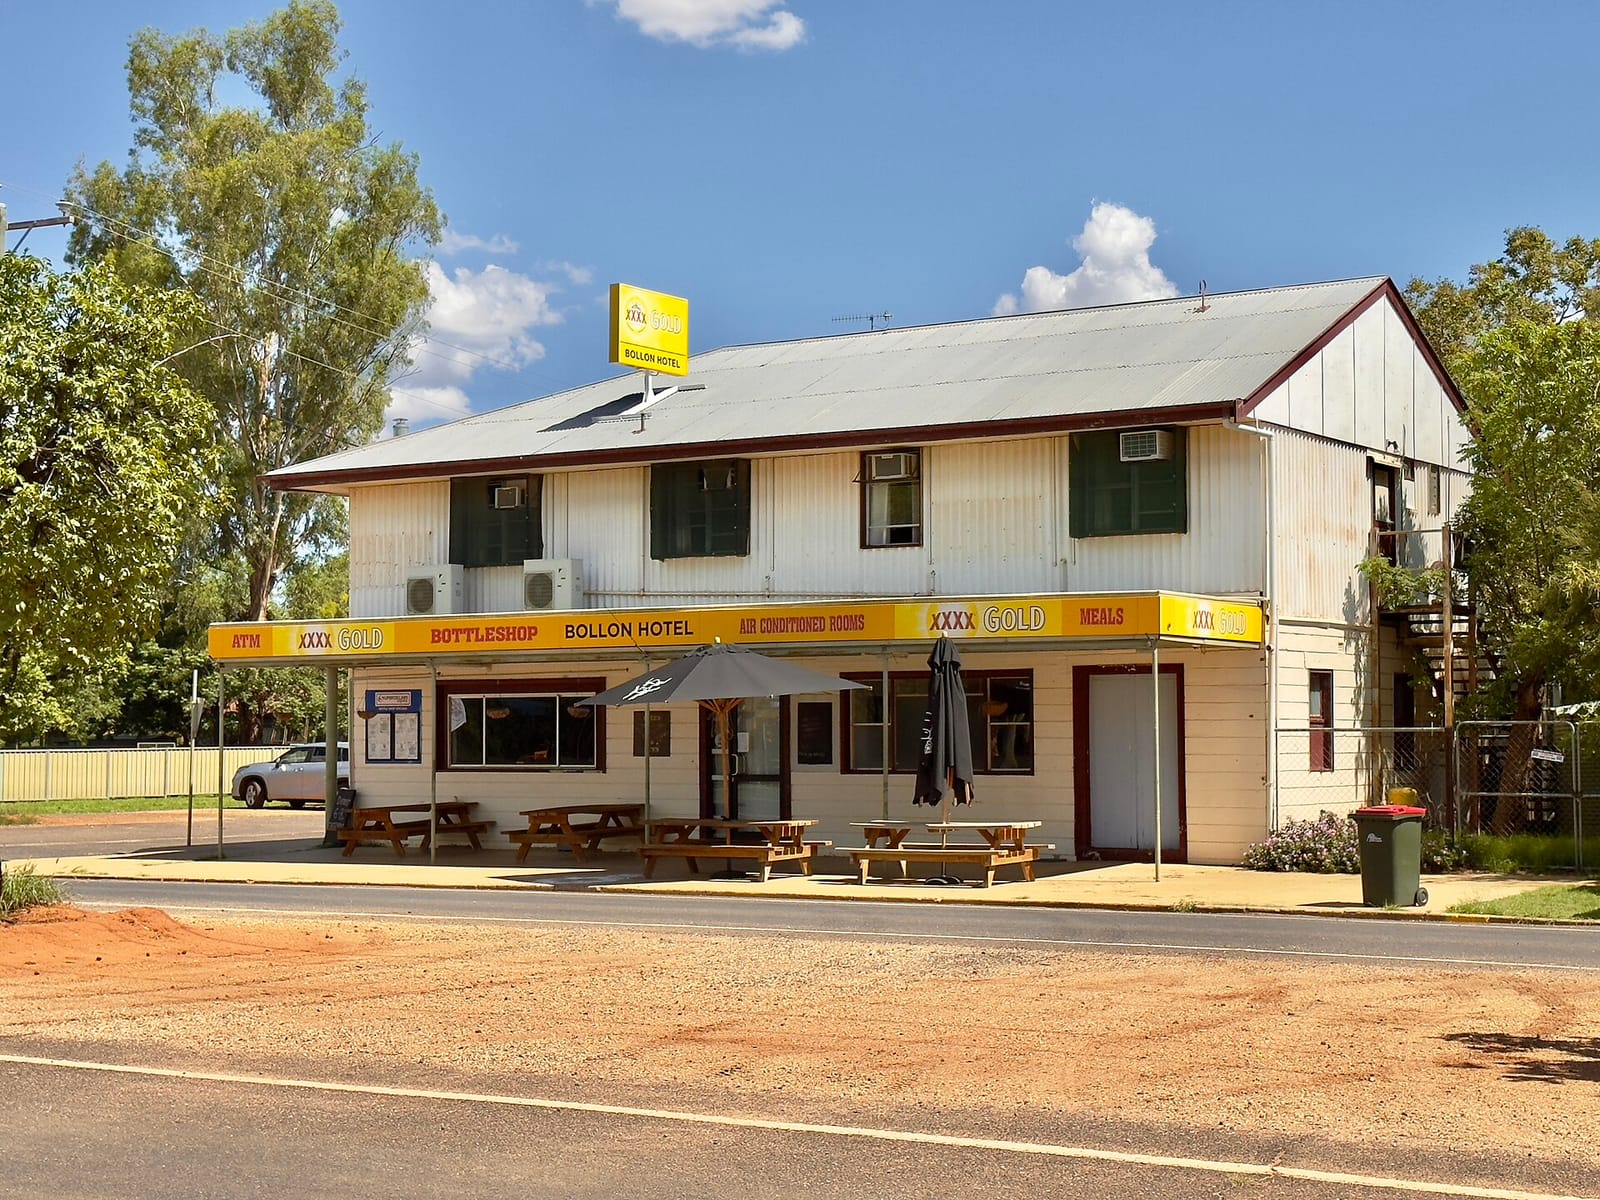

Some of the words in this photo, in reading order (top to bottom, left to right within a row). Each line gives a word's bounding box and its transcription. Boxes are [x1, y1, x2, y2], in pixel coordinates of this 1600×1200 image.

[626, 309, 647, 324] XXXX
[650, 309, 682, 334] GOLD
[625, 349, 655, 363] BOLLON
[657, 355, 681, 368] HOTEL
[740, 618, 757, 634] AIR
[760, 616, 825, 634] CONDITIONED
[829, 614, 865, 631] ROOMS
[929, 610, 976, 630] XXXX
[983, 606, 1045, 632] GOLD
[1080, 608, 1124, 625] MEALS
[1193, 610, 1215, 630] XXXX
[1218, 608, 1247, 635] GOLD
[299, 632, 332, 649] XXXX
[338, 627, 383, 650] GOLD
[431, 626, 538, 644] BOTTLESHOP
[565, 622, 632, 639] BOLLON
[638, 620, 693, 636] HOTEL
[232, 633, 260, 648] ATM
